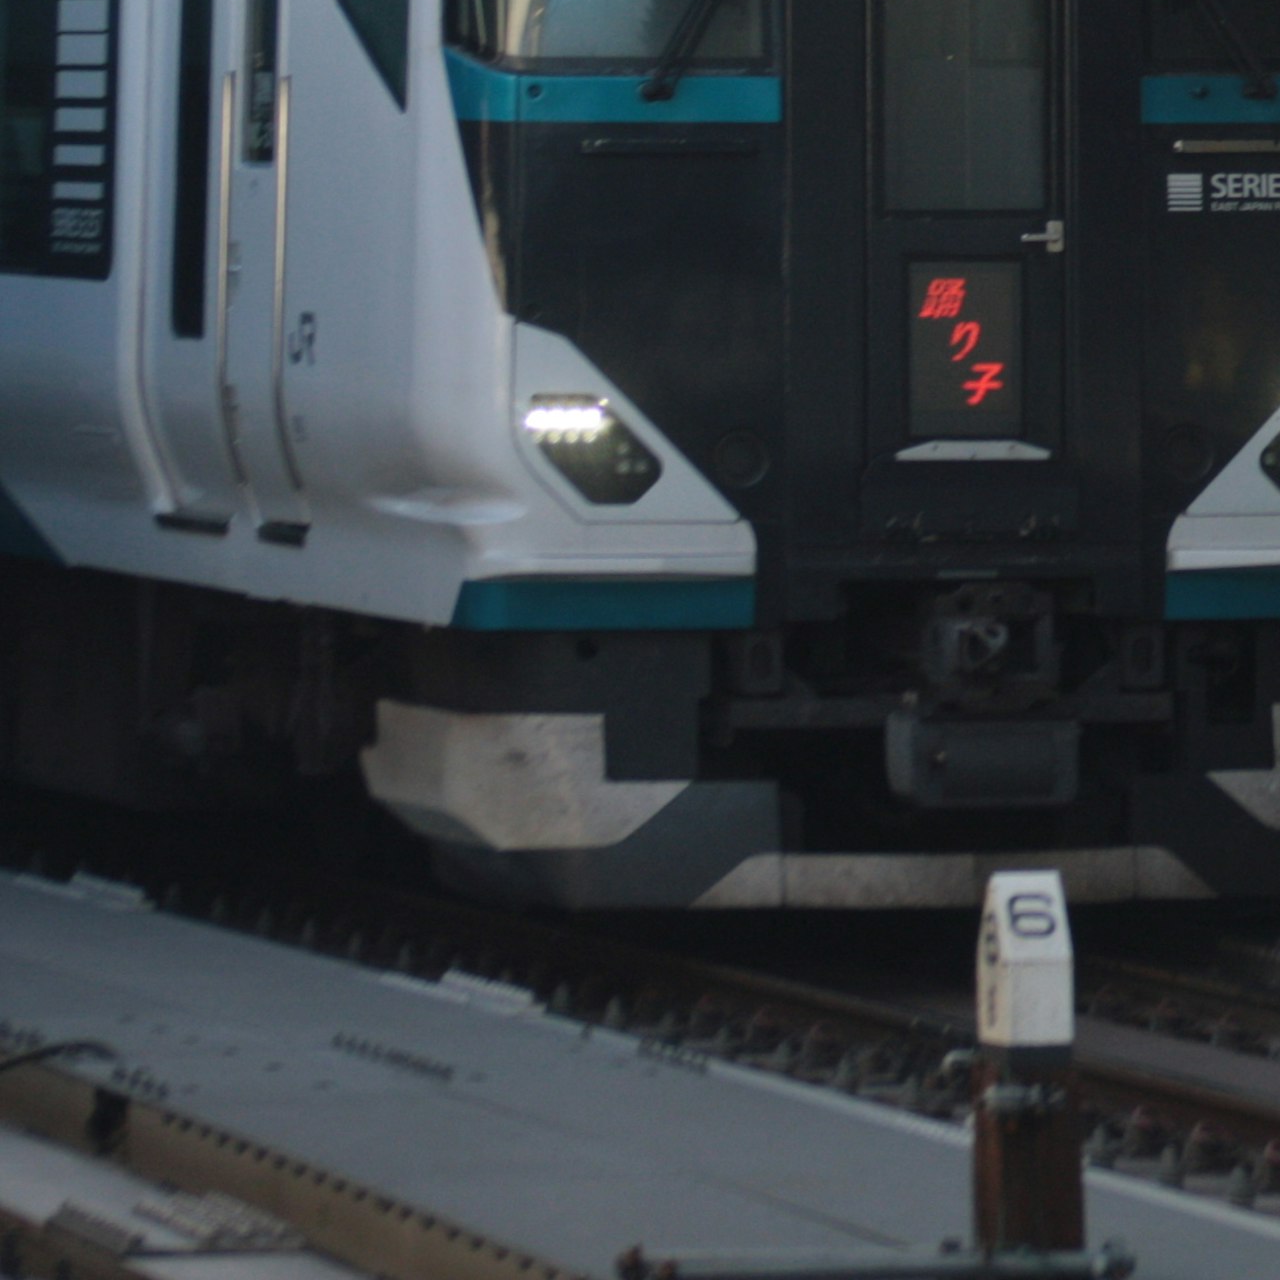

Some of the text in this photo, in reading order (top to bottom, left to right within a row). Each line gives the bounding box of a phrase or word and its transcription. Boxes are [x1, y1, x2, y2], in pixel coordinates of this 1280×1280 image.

[917, 277, 1005, 406] 踊り子
[1006, 890, 1057, 941] 6
